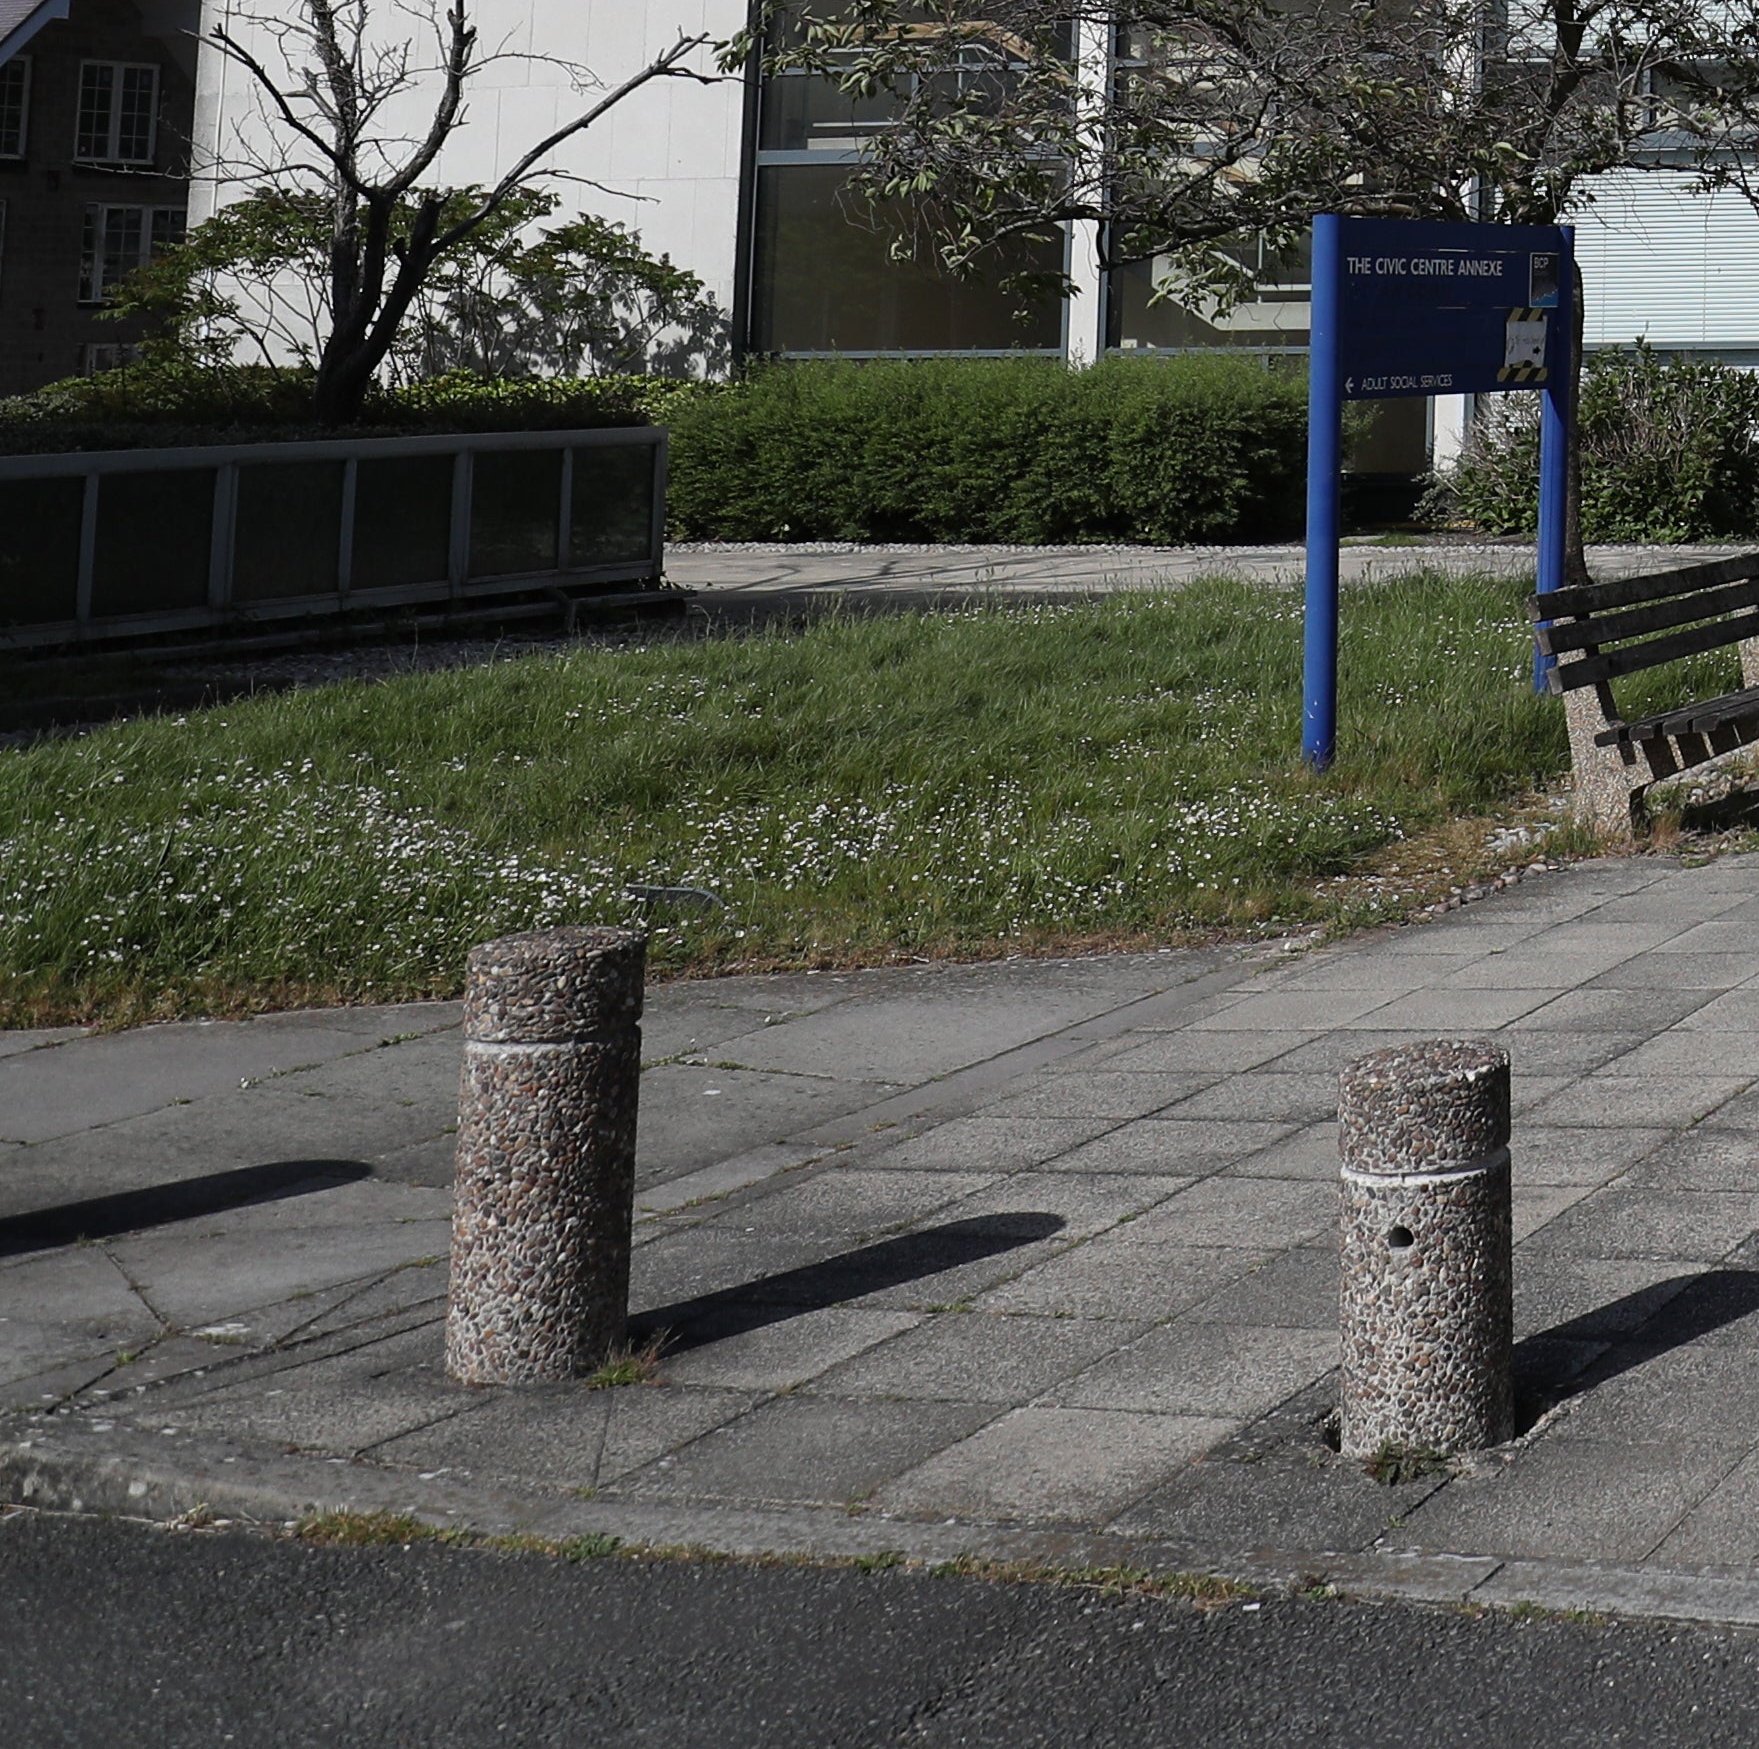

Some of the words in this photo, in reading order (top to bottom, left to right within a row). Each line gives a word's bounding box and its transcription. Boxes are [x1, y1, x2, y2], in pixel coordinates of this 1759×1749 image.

[1347, 257, 1371, 275] THE
[1375, 258, 1407, 275] CIVIC
[1410, 258, 1454, 276] CENTRE
[1457, 259, 1503, 276] ANNEXE
[1534, 257, 1549, 269] BCP
[1361, 377, 1388, 391] ADULT
[1390, 375, 1418, 390] SOCIAL
[1420, 374, 1452, 388] SERVICES
